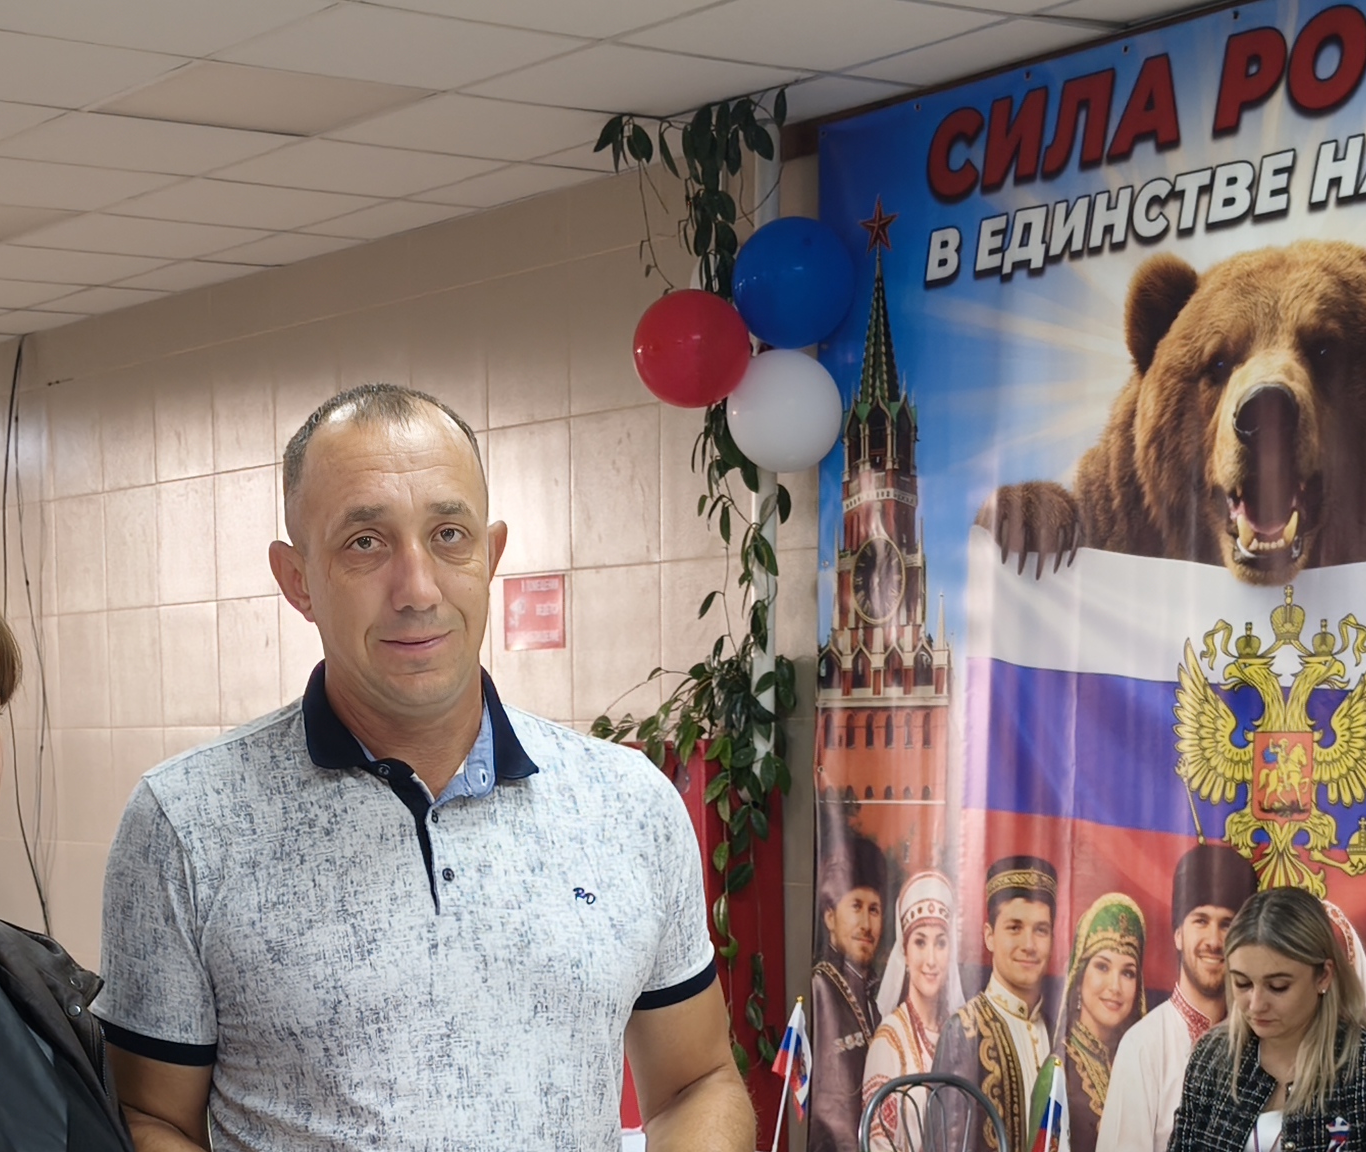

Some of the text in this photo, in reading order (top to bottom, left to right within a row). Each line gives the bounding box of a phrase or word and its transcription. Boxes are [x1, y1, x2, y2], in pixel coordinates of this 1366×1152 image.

[926, 52, 1181, 200] СИЛА
[924, 225, 962, 285] В
[974, 149, 1297, 277] ЕДИНСТВЕ
